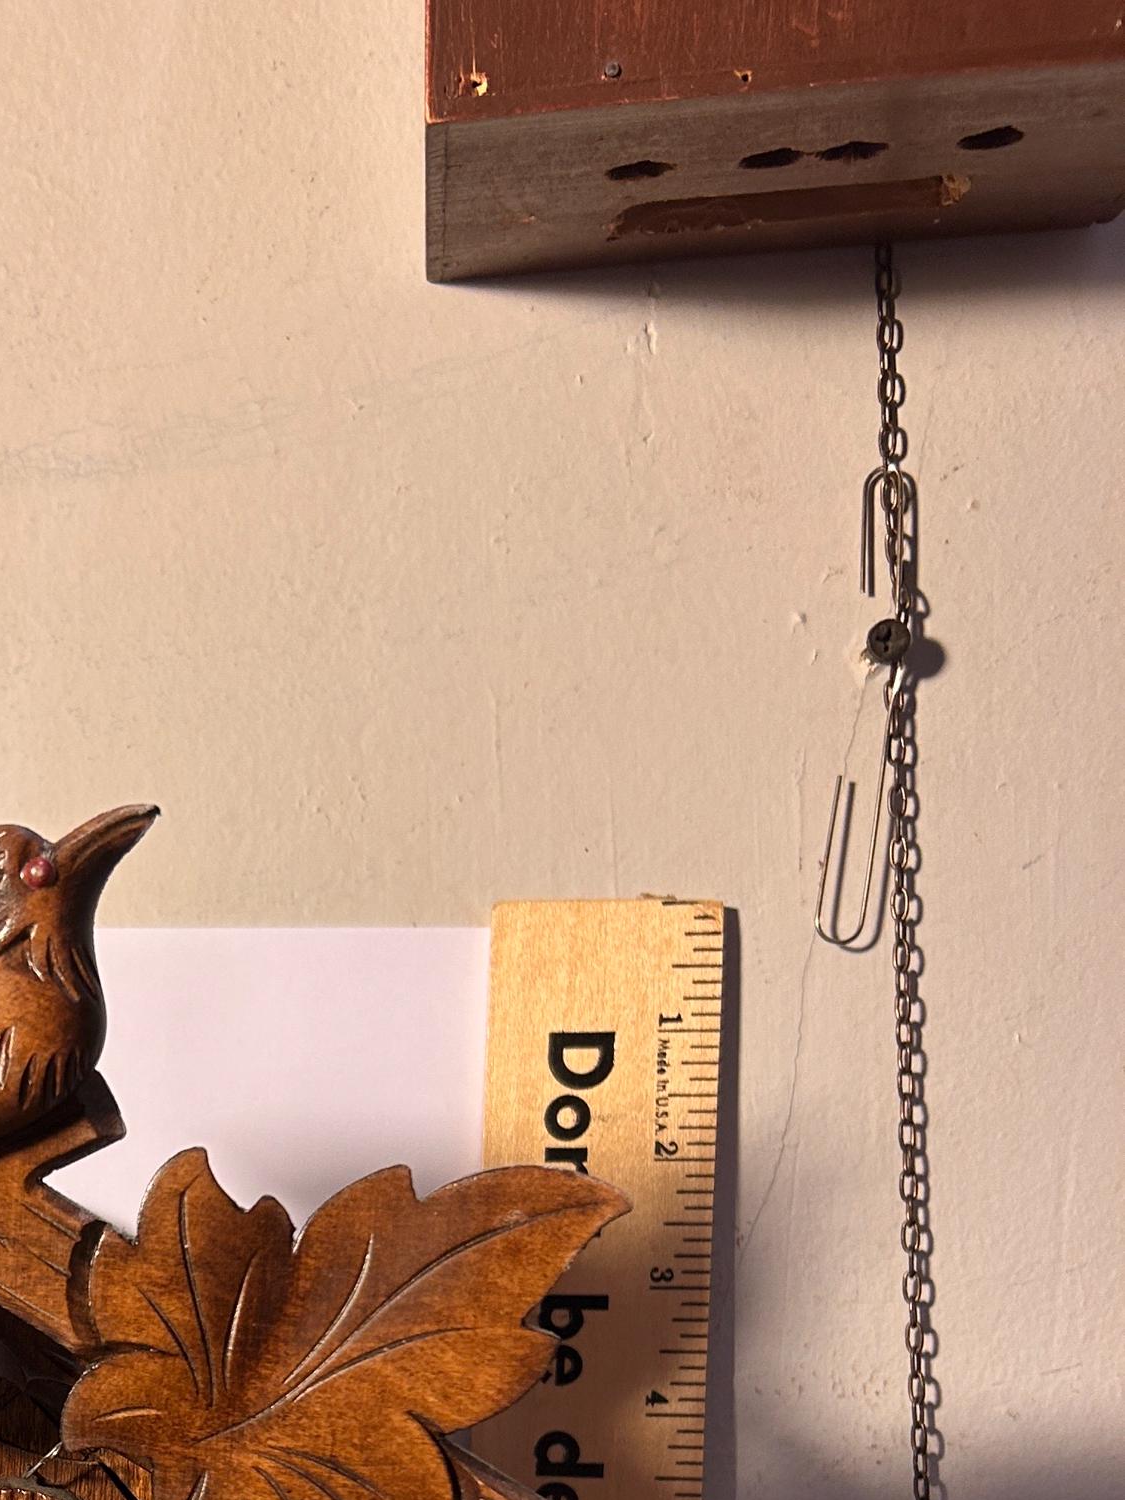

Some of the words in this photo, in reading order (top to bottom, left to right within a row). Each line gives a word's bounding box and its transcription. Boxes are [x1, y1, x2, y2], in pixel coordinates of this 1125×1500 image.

[659, 1013, 683, 1026] 1
[657, 1038, 670, 1074] Made
[654, 1141, 678, 1157] 2
[649, 1267, 674, 1283] 3
[645, 1389, 669, 1407] 4
